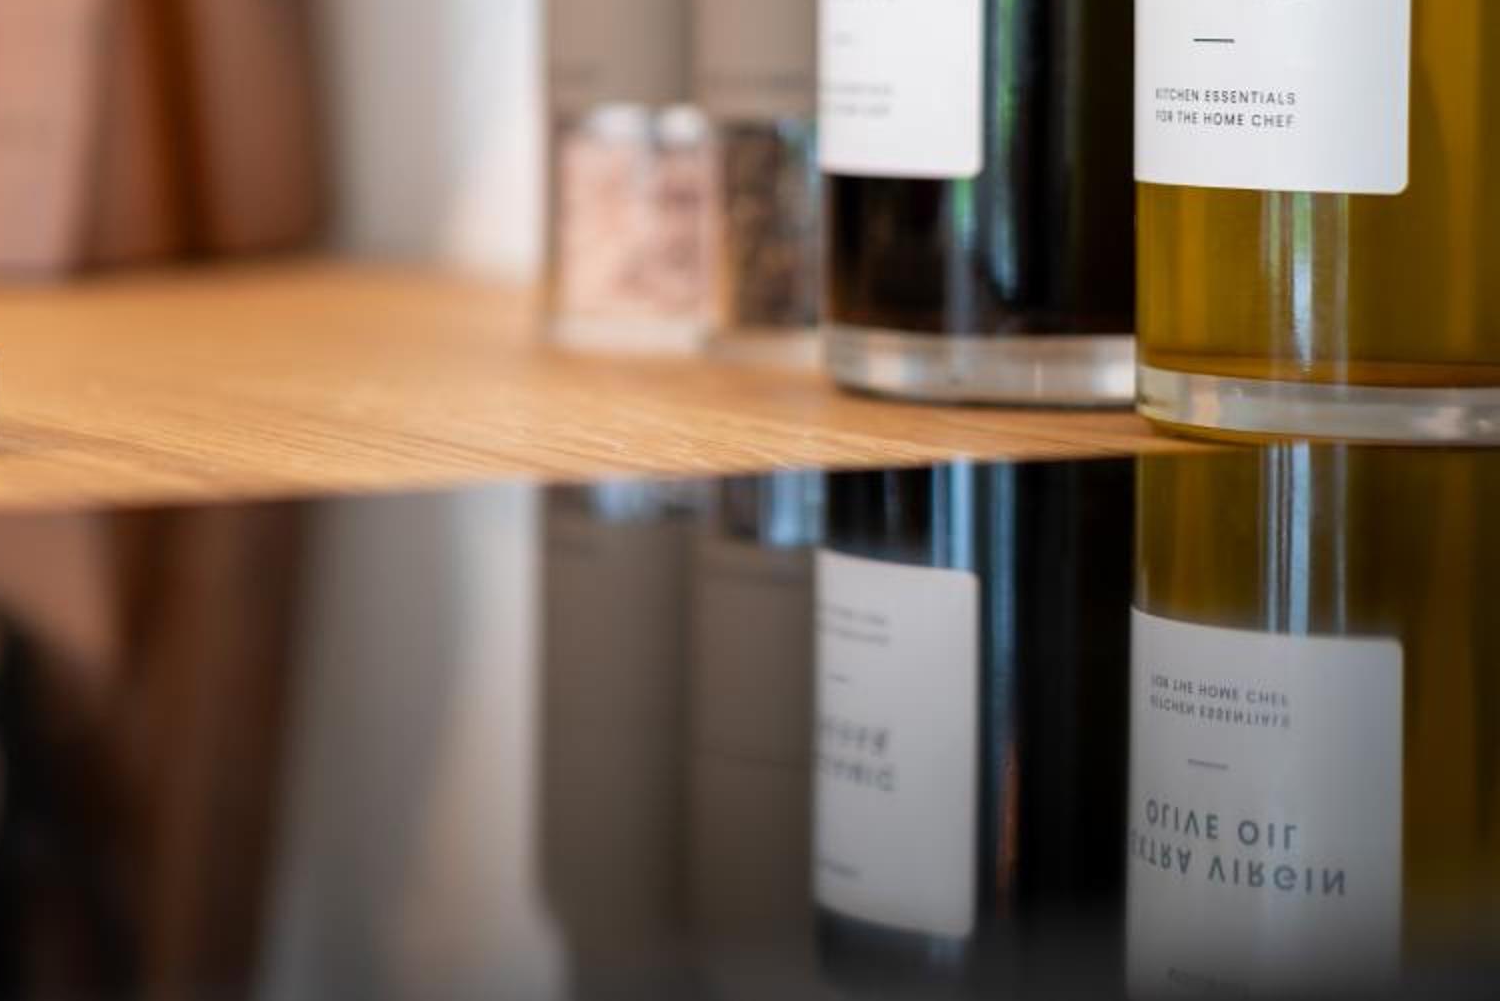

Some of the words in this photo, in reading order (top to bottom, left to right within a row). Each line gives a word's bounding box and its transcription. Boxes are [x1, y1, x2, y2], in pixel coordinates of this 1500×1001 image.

[1204, 89, 1296, 106] ESSENTIALS
[1176, 109, 1199, 125] THE
[1203, 111, 1245, 127] HOME
[1251, 113, 1296, 128] CHEF
